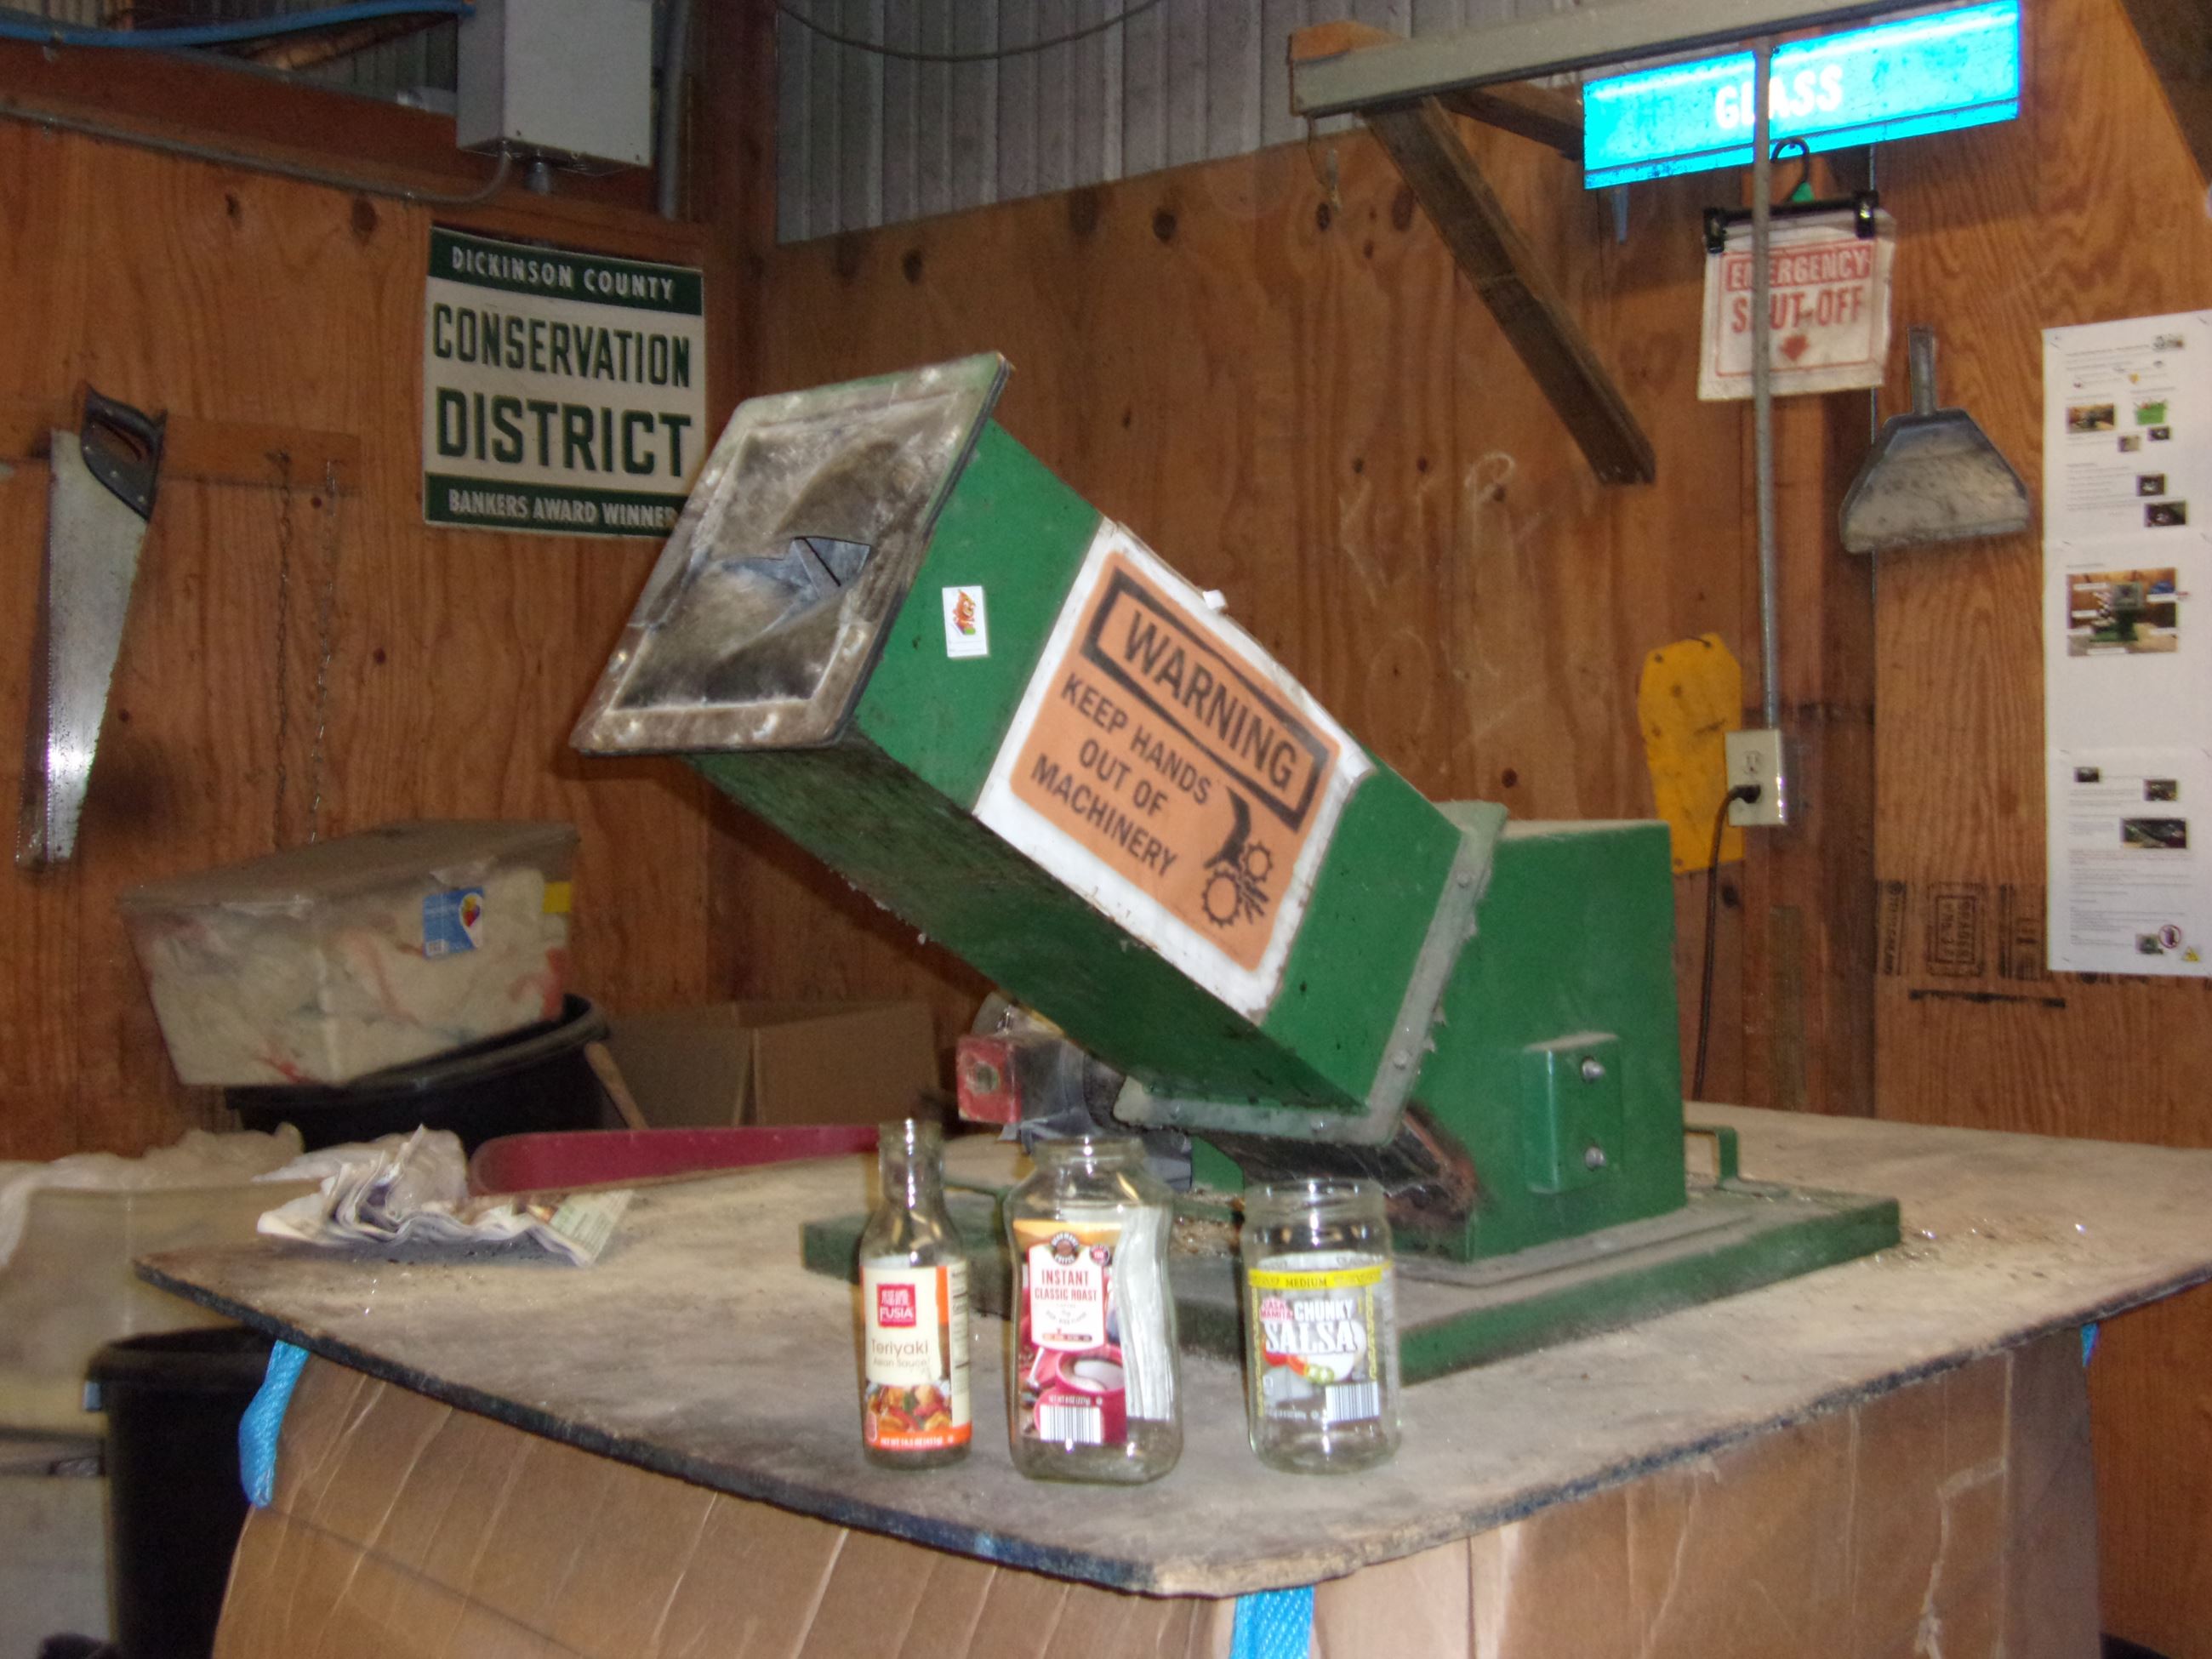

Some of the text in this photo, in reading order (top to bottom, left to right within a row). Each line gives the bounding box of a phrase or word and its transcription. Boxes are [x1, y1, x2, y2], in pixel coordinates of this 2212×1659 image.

[1715, 64, 1843, 128] GLASS
[451, 246, 674, 302] DICKINSON COUNTY
[432, 302, 690, 387] CONSERVATION
[436, 385, 692, 477] DISTRICT
[448, 488, 527, 519] BANKERS
[533, 496, 596, 522] AWARD
[1125, 610, 1297, 793] WARNING
[1061, 671, 1211, 805] KEEP HANDS
[1079, 738, 1169, 817] OUT OF
[1030, 753, 1178, 876] MACHINERY
[1035, 1287, 1097, 1302] CLASSIC ROAST
[1041, 1268, 1089, 1287] INSTANT
[1286, 1278, 1327, 1288] MEDIUM
[880, 1307, 914, 1322] FUSIA
[1294, 1299, 1353, 1321] CHUNKY
[871, 1338, 929, 1360] Teriyaki
[1265, 1320, 1357, 1354] SALSA
